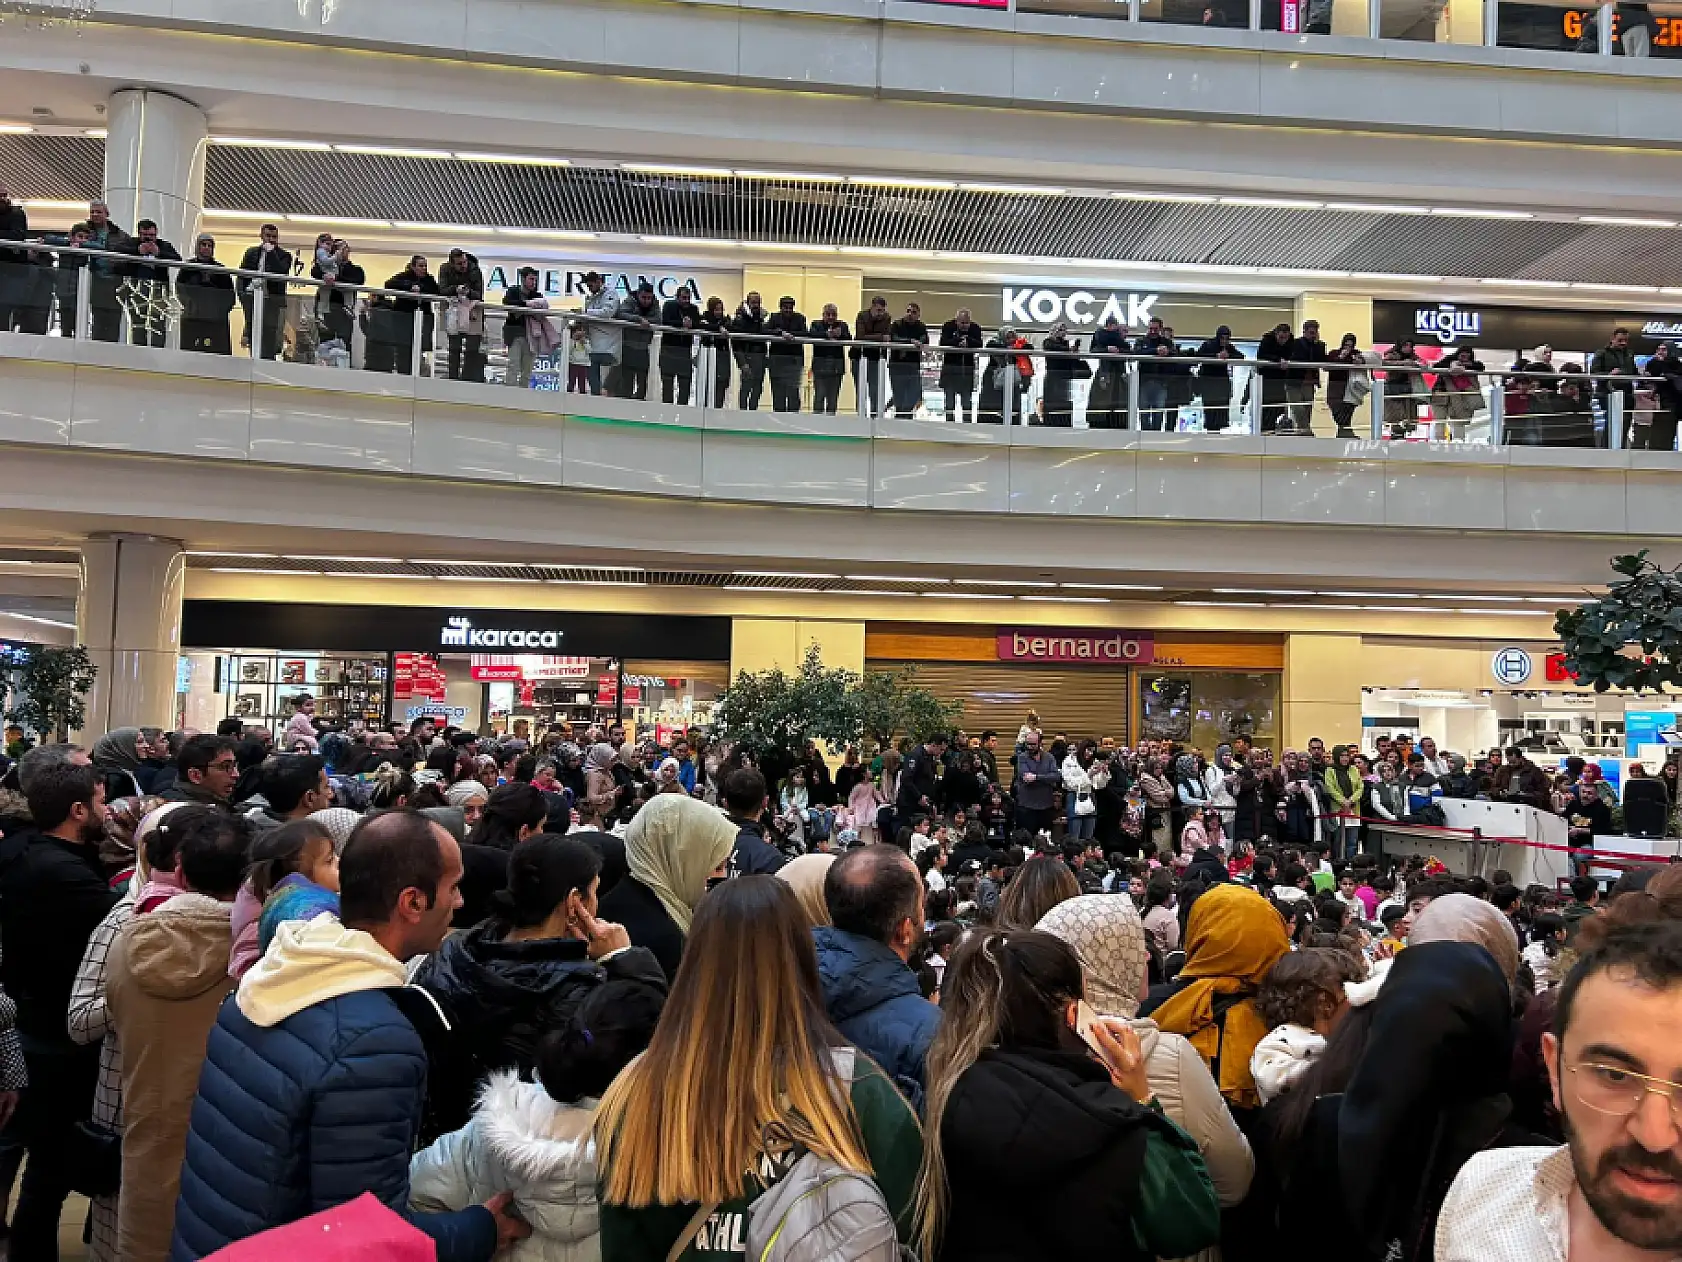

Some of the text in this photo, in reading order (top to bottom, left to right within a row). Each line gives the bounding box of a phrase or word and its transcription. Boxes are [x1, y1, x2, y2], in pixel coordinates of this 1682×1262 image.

[469, 628, 558, 648] karaca
[1013, 631, 1140, 659] bernardo
[695, 1211, 747, 1252] ATHL
